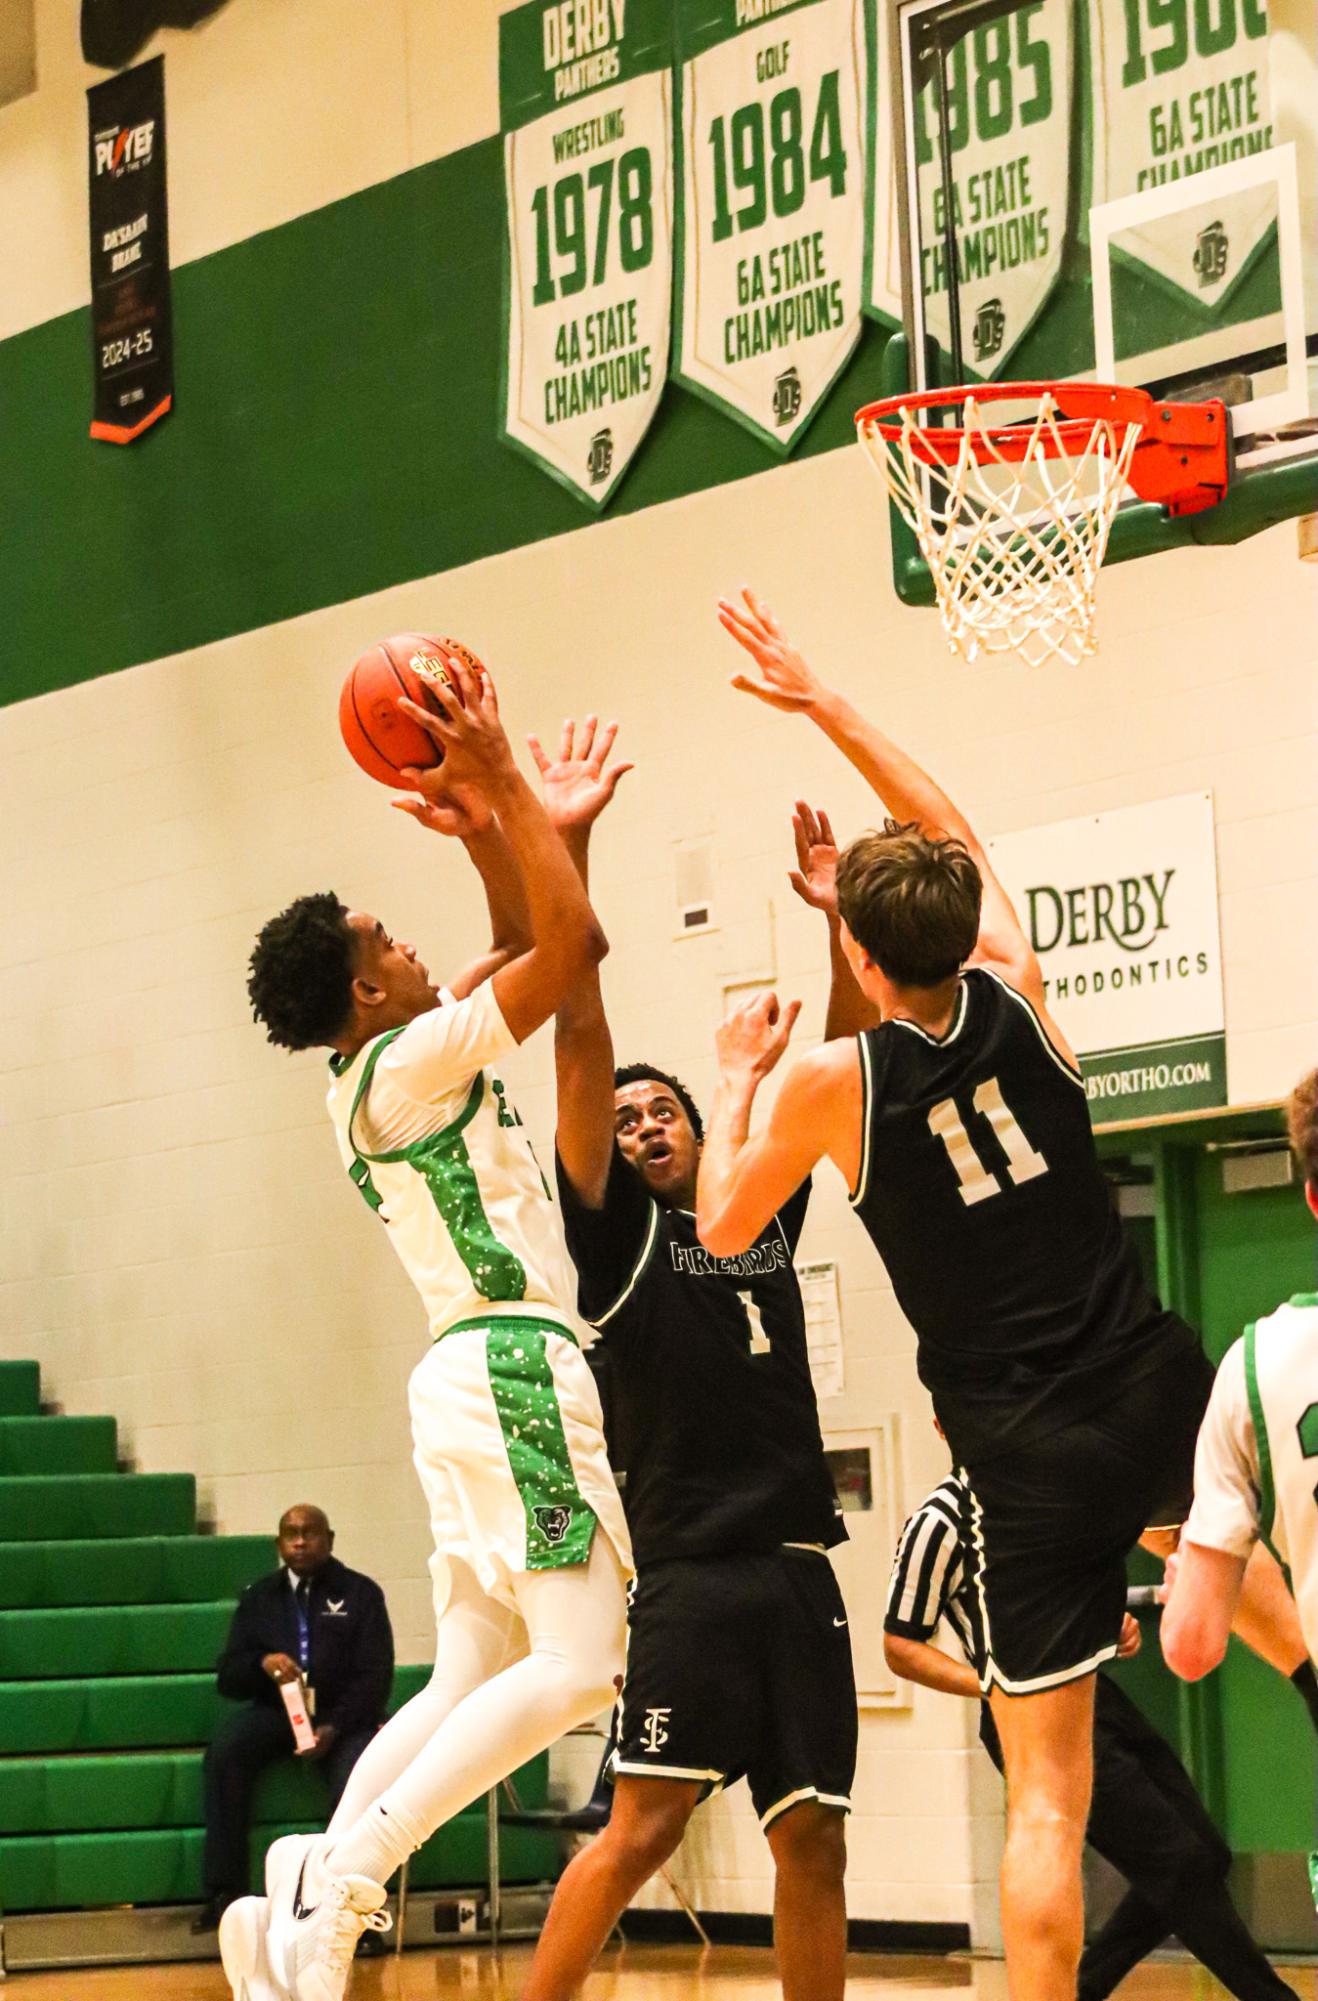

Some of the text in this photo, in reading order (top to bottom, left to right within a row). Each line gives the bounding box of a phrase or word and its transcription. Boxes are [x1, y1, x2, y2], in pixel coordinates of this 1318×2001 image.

[543, 0, 625, 71] DERBY
[756, 40, 790, 83] GOLF
[555, 46, 620, 101] PANTHERS
[553, 107, 625, 164] WRESTLING
[1150, 70, 1259, 157] 6A STATE
[708, 69, 847, 244] 1984
[968, 155, 1031, 224] STATE
[531, 146, 653, 307] 1978
[737, 231, 825, 306] 6A STATE
[102, 328, 153, 369] 2024-25
[555, 299, 637, 368] 4A STATE
[724, 279, 844, 365] CHAMPIONS
[545, 345, 652, 425] CHAMPIONS
[1025, 868, 1176, 954] DERBY
[1042, 952, 1208, 1001] THODONTICS
[1084, 1061, 1212, 1101] BYORTHO.COM
[927, 1076, 1049, 1207] 11
[737, 1290, 771, 1355] 1
